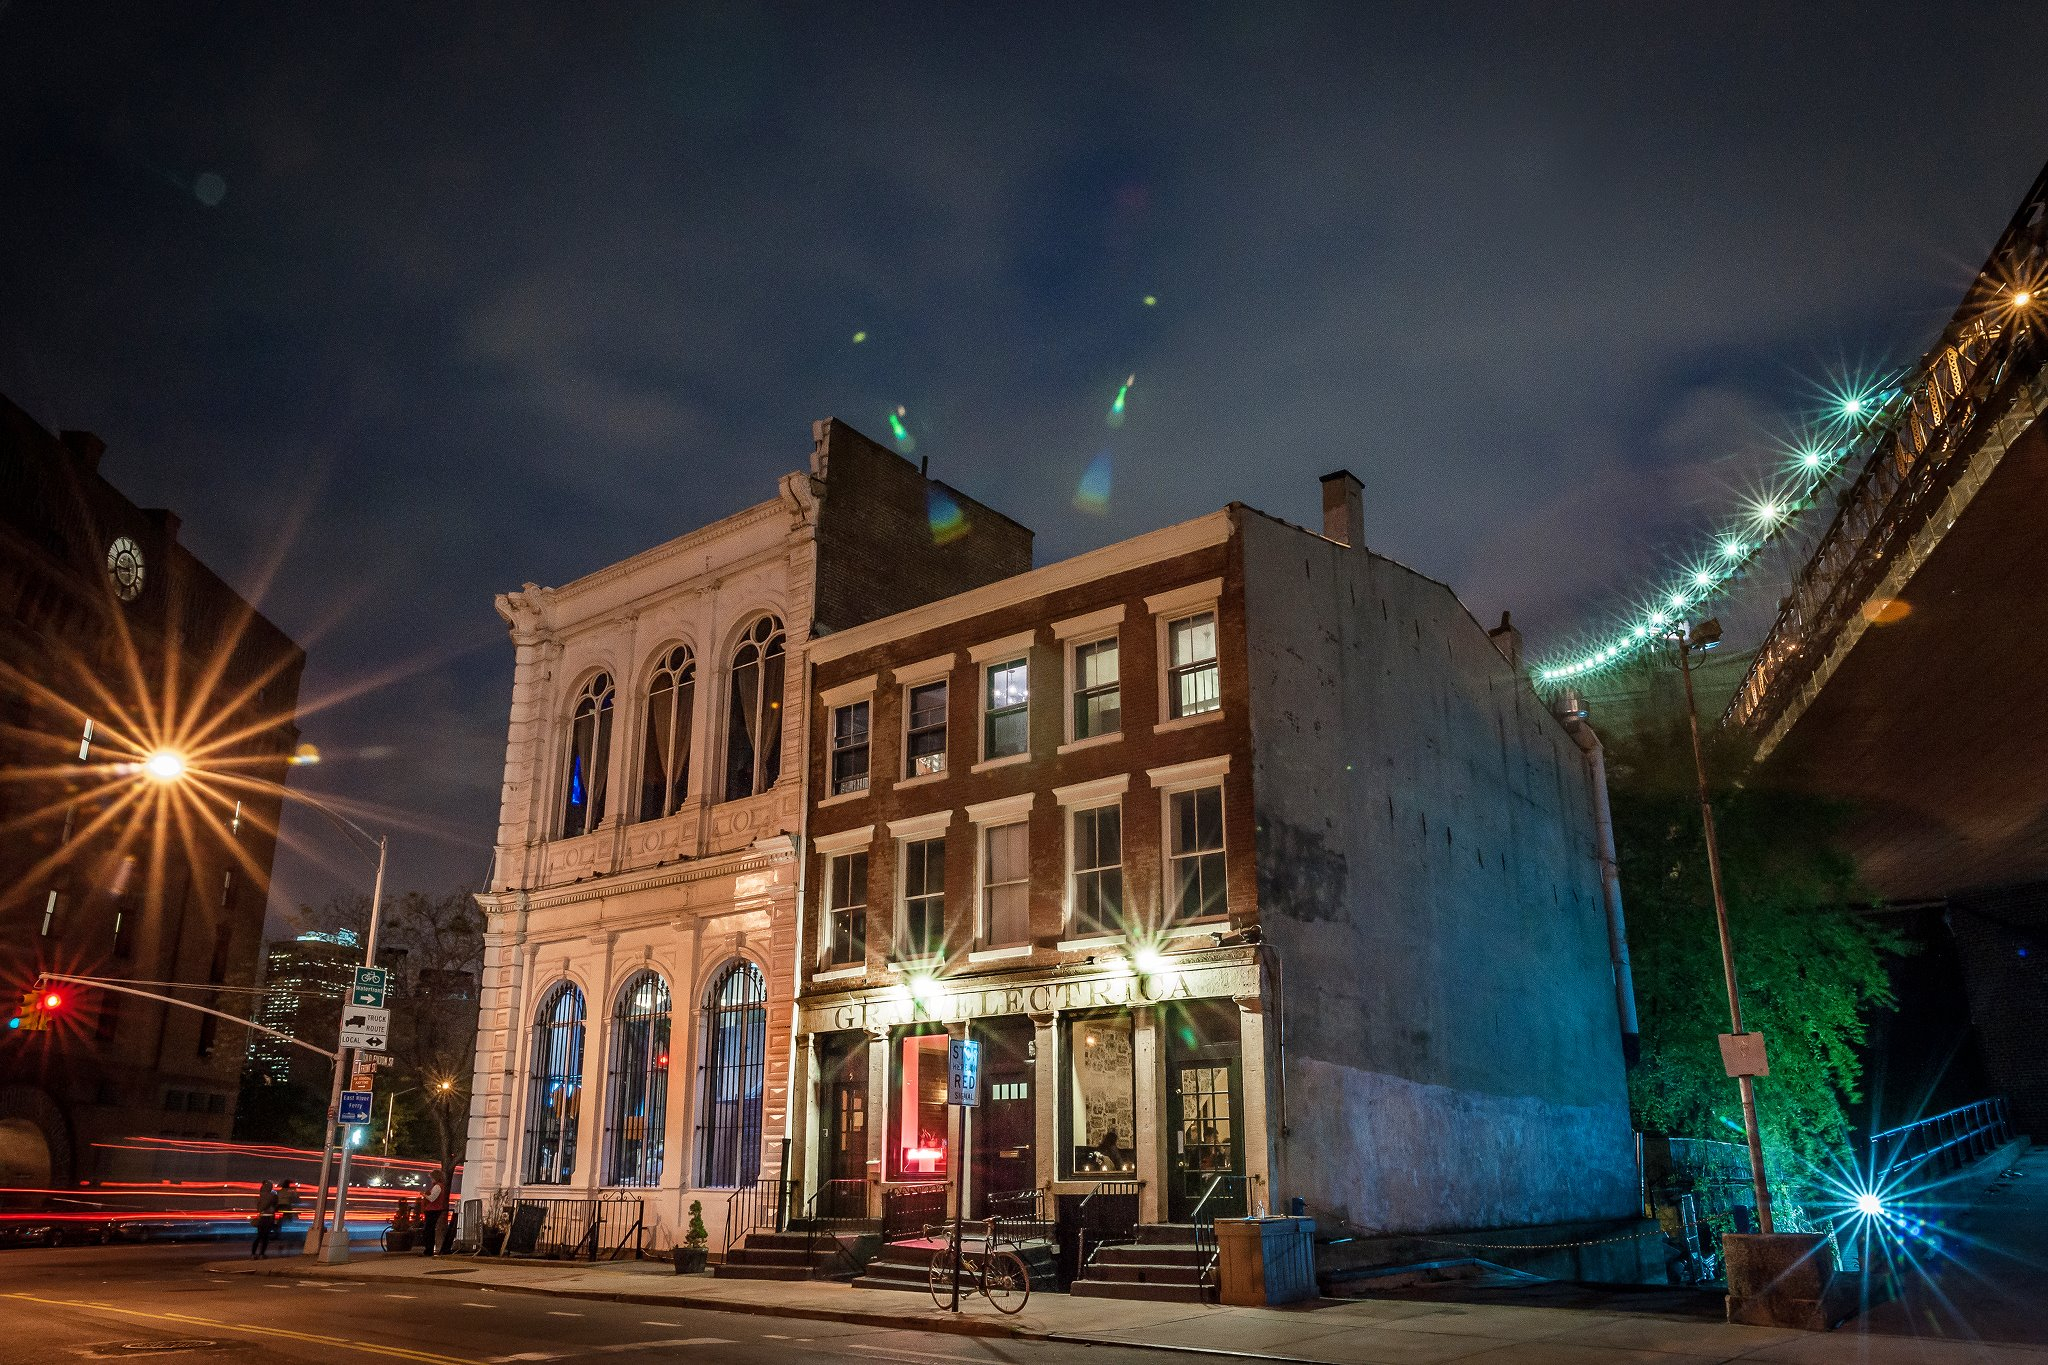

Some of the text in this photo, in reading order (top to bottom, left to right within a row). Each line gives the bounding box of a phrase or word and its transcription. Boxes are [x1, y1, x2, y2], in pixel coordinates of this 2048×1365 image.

[952, 973, 1198, 1019] ELECTRICA
[367, 1014, 387, 1023] TRUCK
[366, 1025, 385, 1033] ROUTE
[953, 1063, 967, 1071] HERE
[954, 1073, 975, 1090] RED
[954, 1092, 974, 1101] SIGNAL
